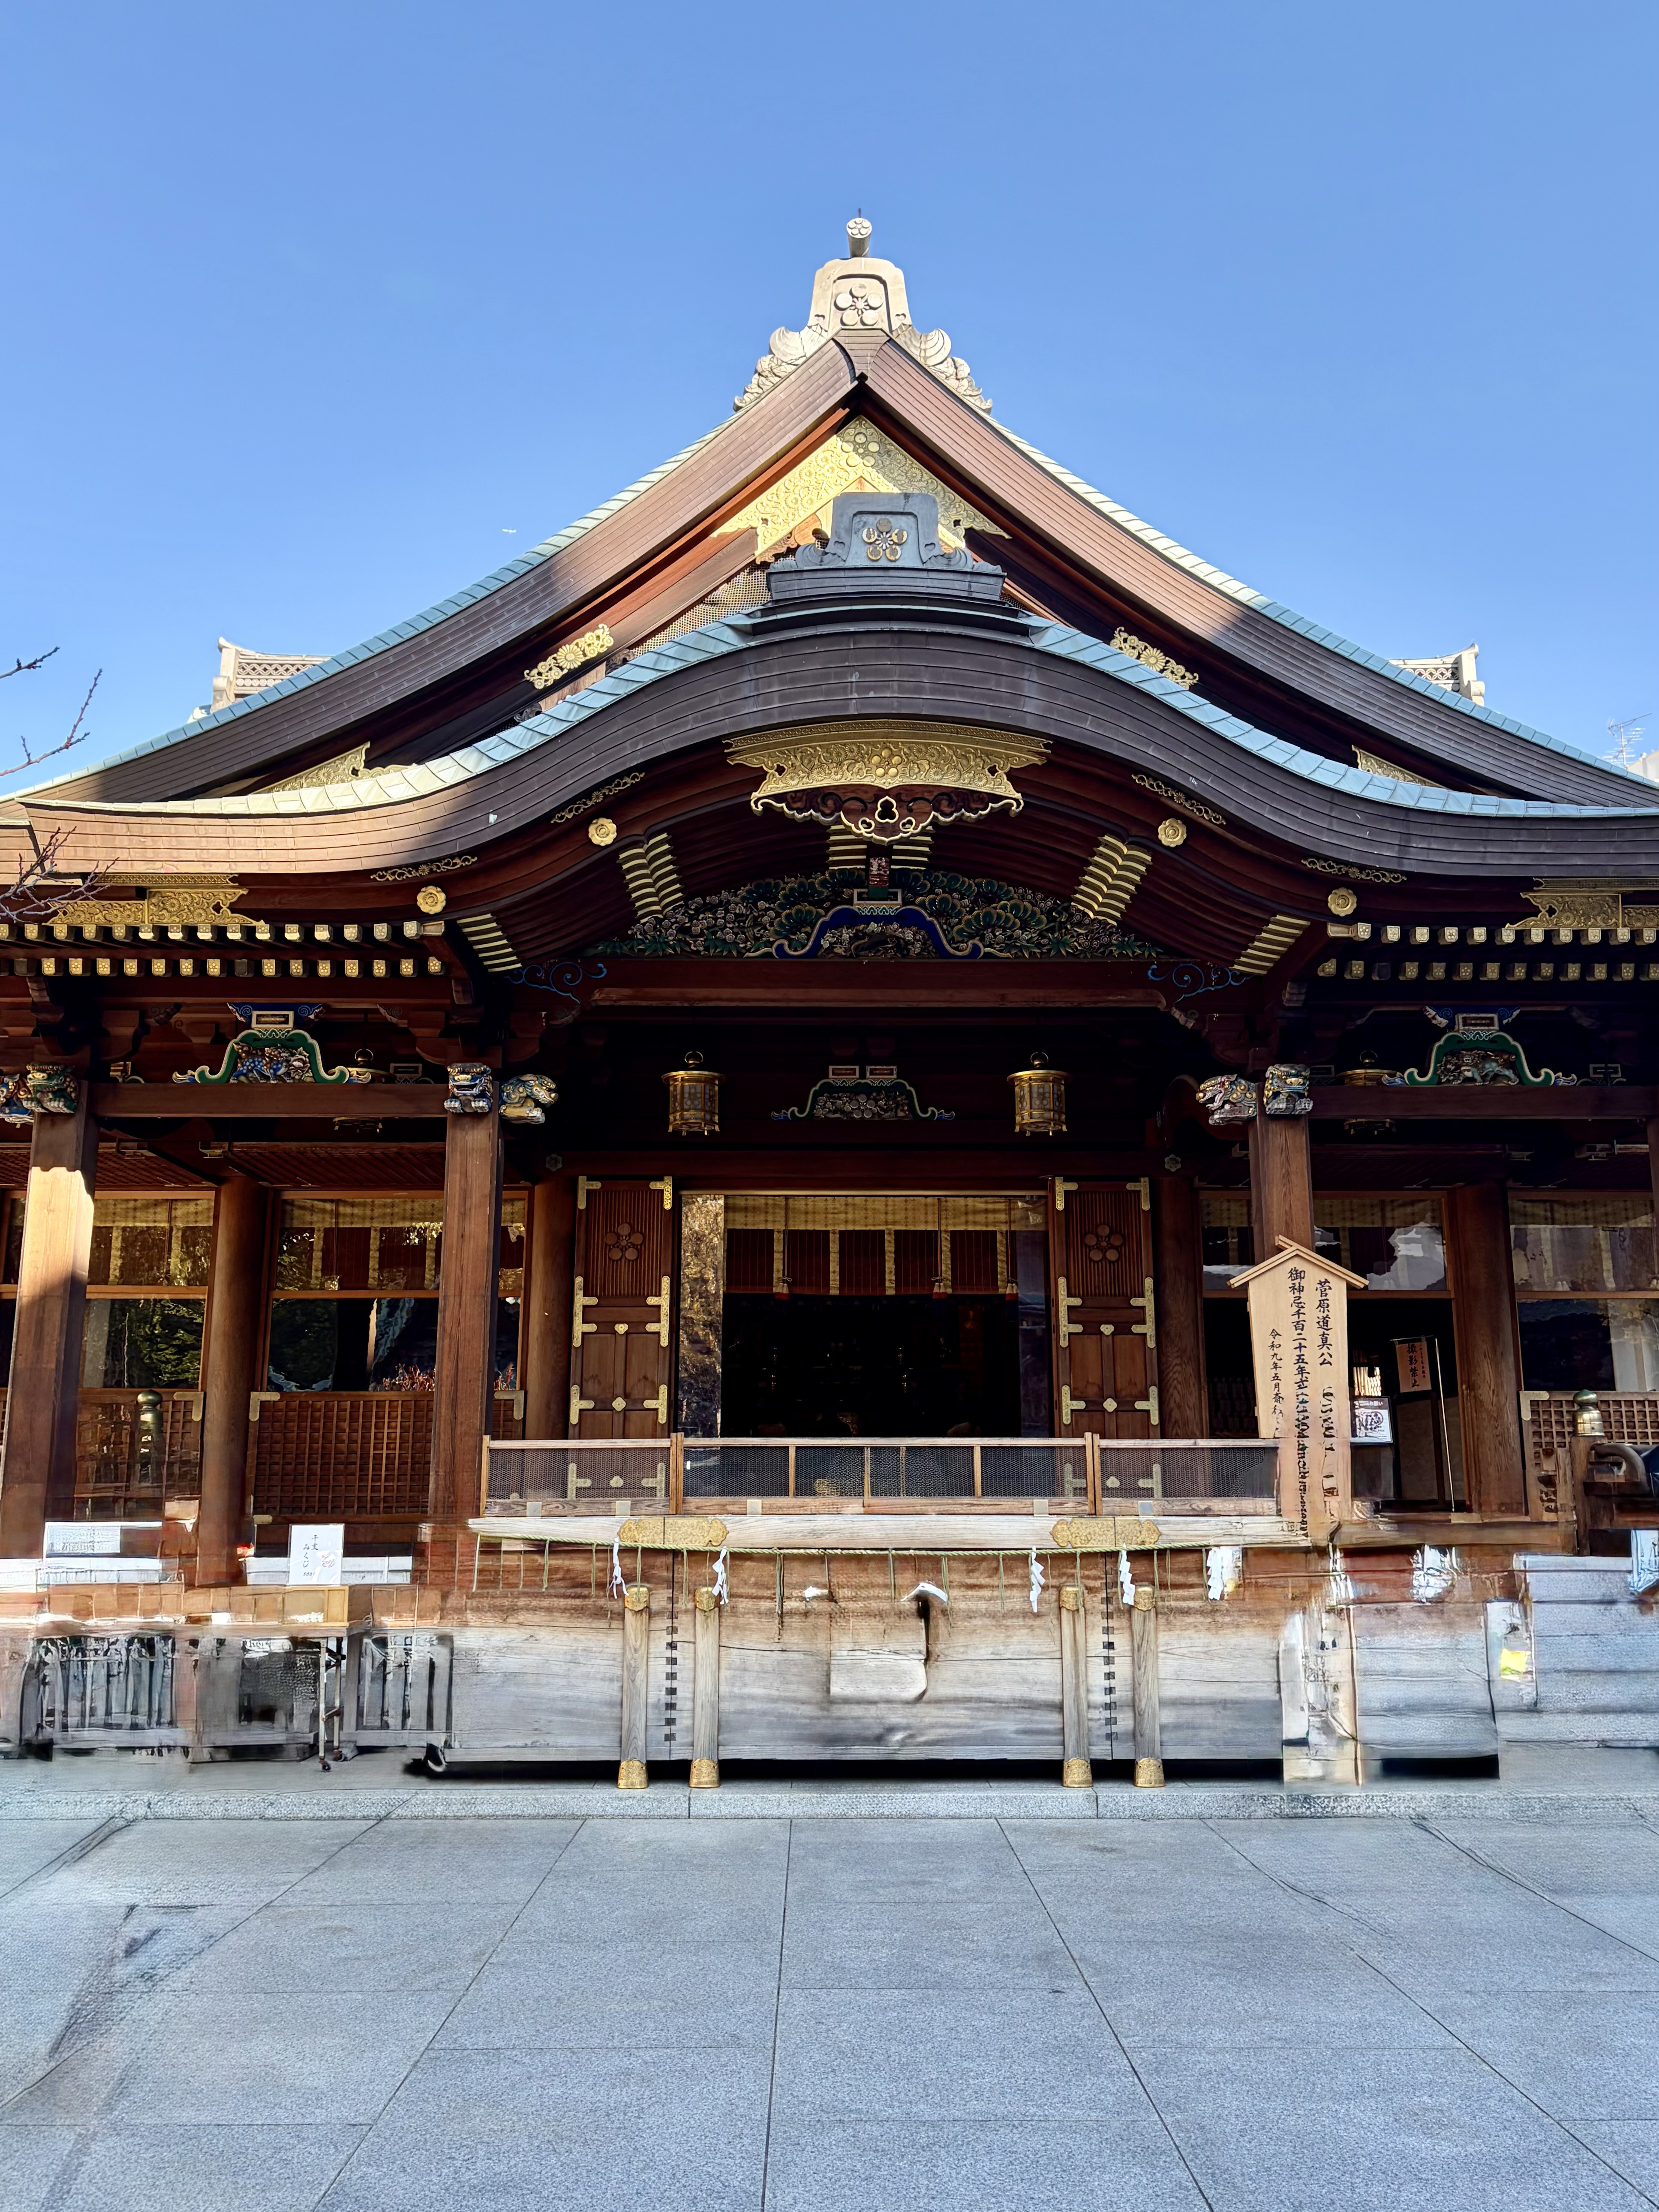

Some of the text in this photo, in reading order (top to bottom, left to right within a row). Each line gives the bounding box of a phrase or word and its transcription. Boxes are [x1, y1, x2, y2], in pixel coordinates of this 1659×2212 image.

[1315, 1278, 1333, 1366] 菅原道真公
